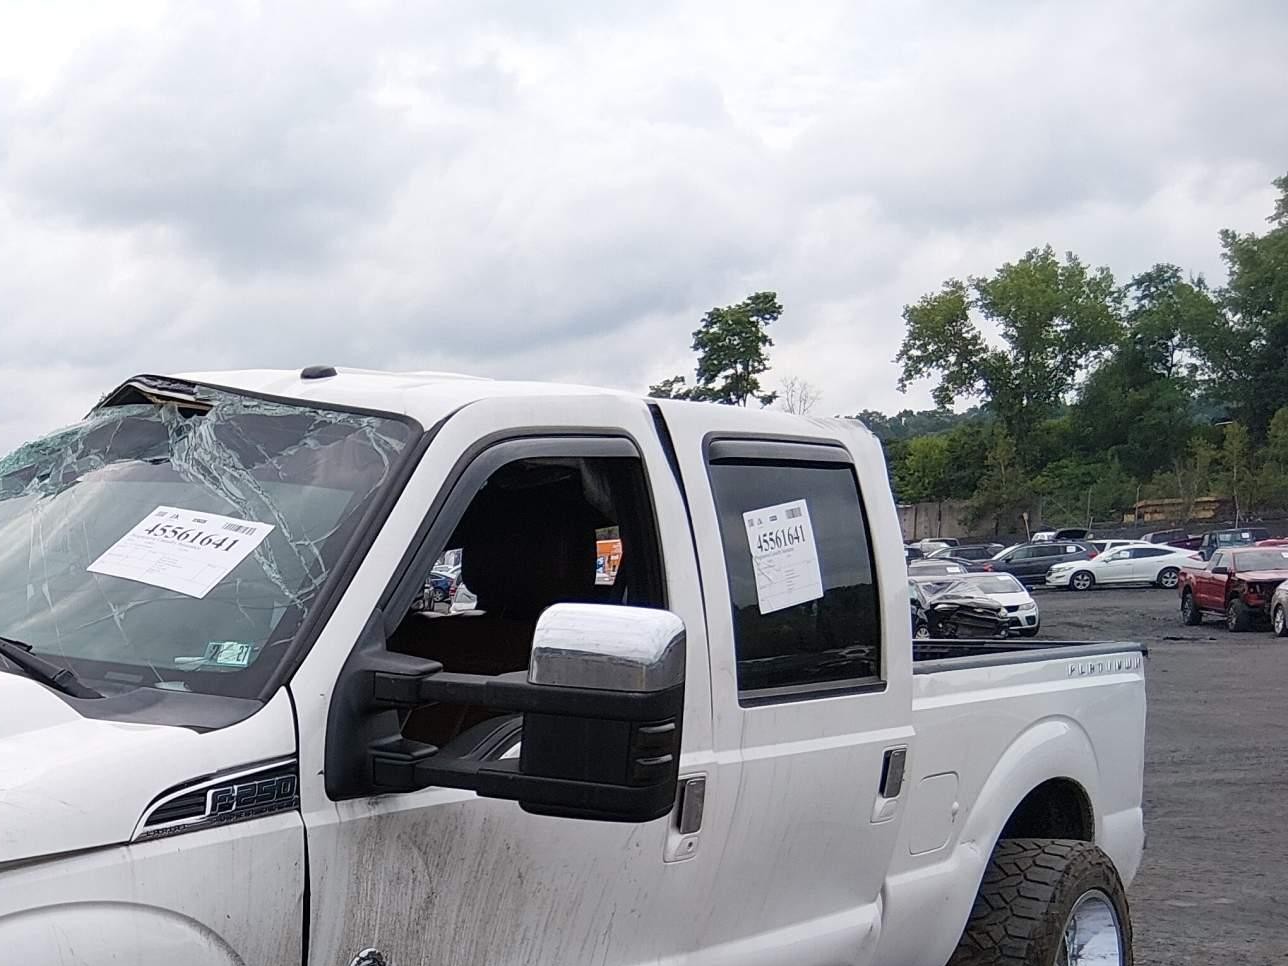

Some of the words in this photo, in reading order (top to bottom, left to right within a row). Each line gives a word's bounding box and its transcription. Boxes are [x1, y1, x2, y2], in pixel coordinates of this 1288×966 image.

[144, 522, 240, 552] 45561641
[756, 524, 806, 553] 45561641
[1068, 656, 1141, 677] PLATINUM
